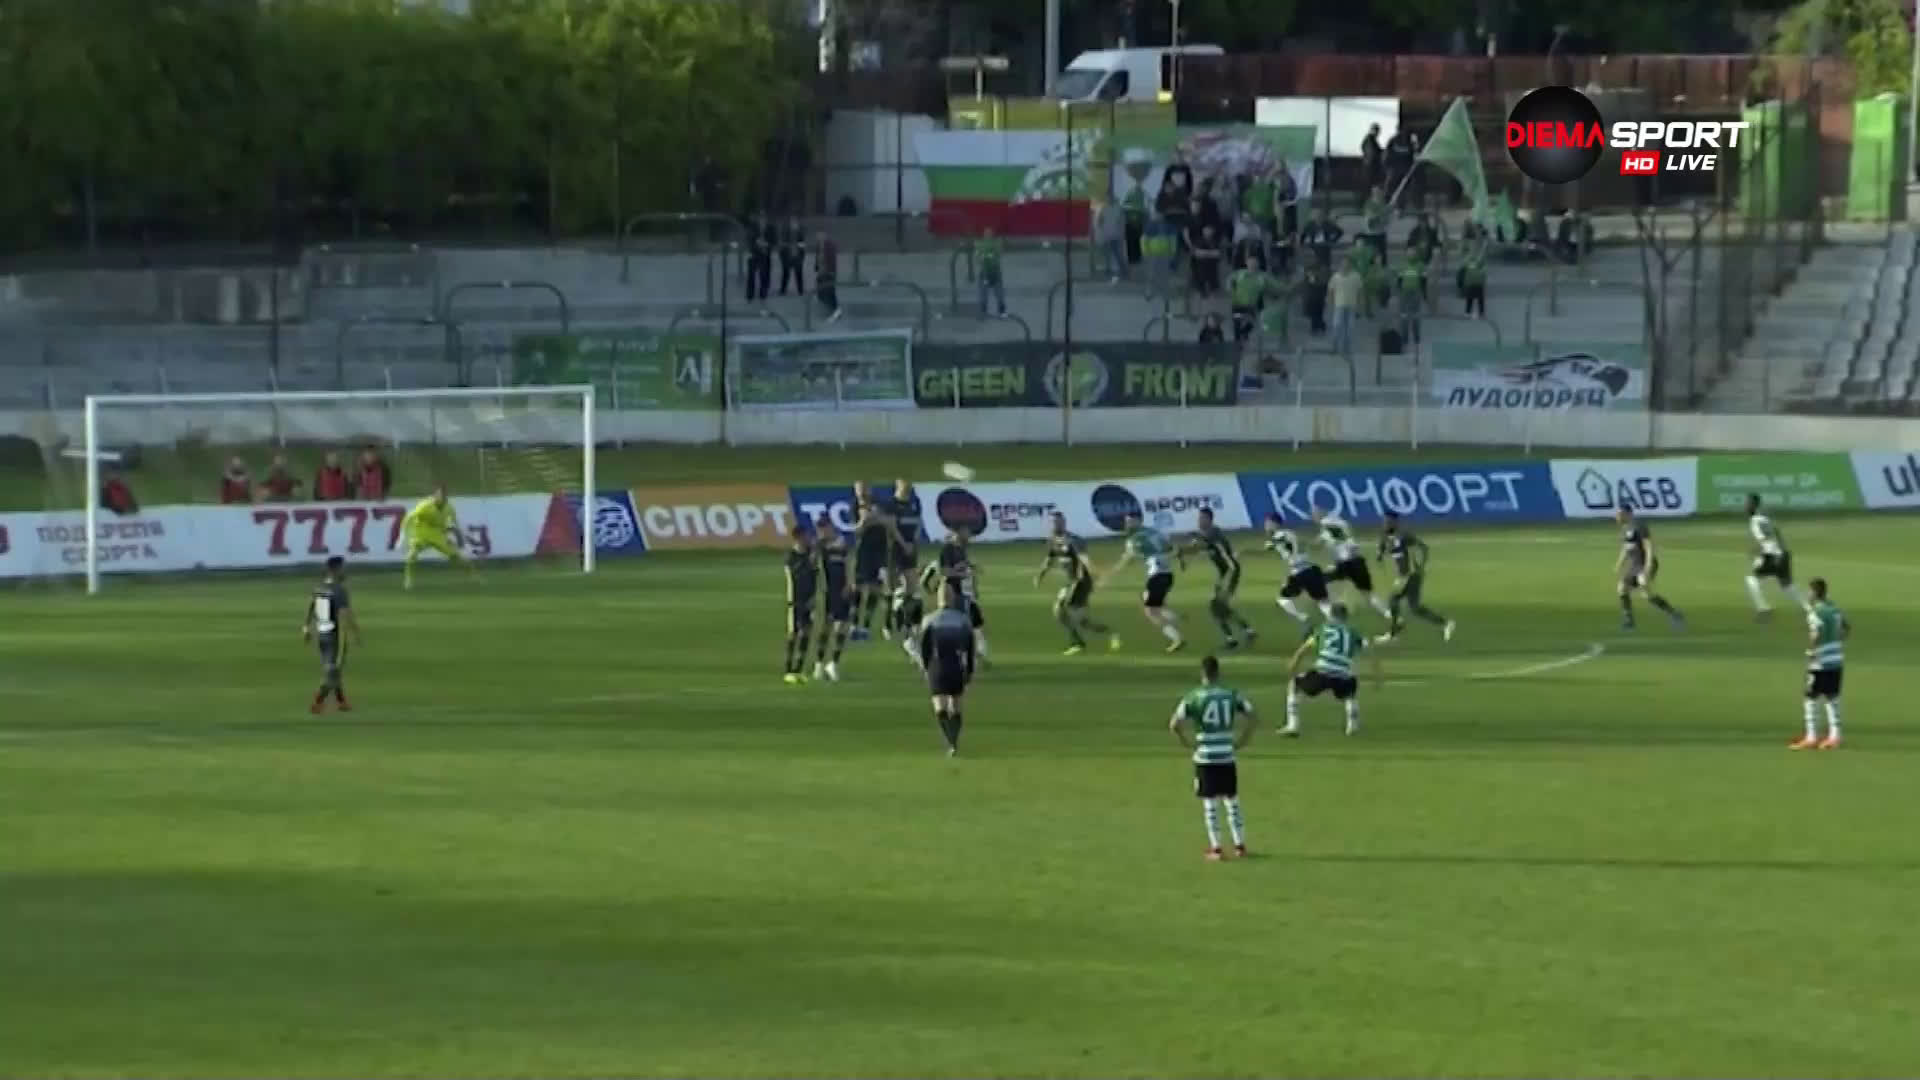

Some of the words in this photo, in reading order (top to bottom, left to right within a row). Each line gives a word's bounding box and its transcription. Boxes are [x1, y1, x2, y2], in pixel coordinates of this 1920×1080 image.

[917, 366, 1026, 398] GREEN
[1123, 362, 1234, 398] FRONT
[1618, 476, 1682, 510] АБВ
[645, 503, 790, 538] СПОРТ
[1324, 624, 1350, 650] 21
[1201, 699, 1231, 725] 41
